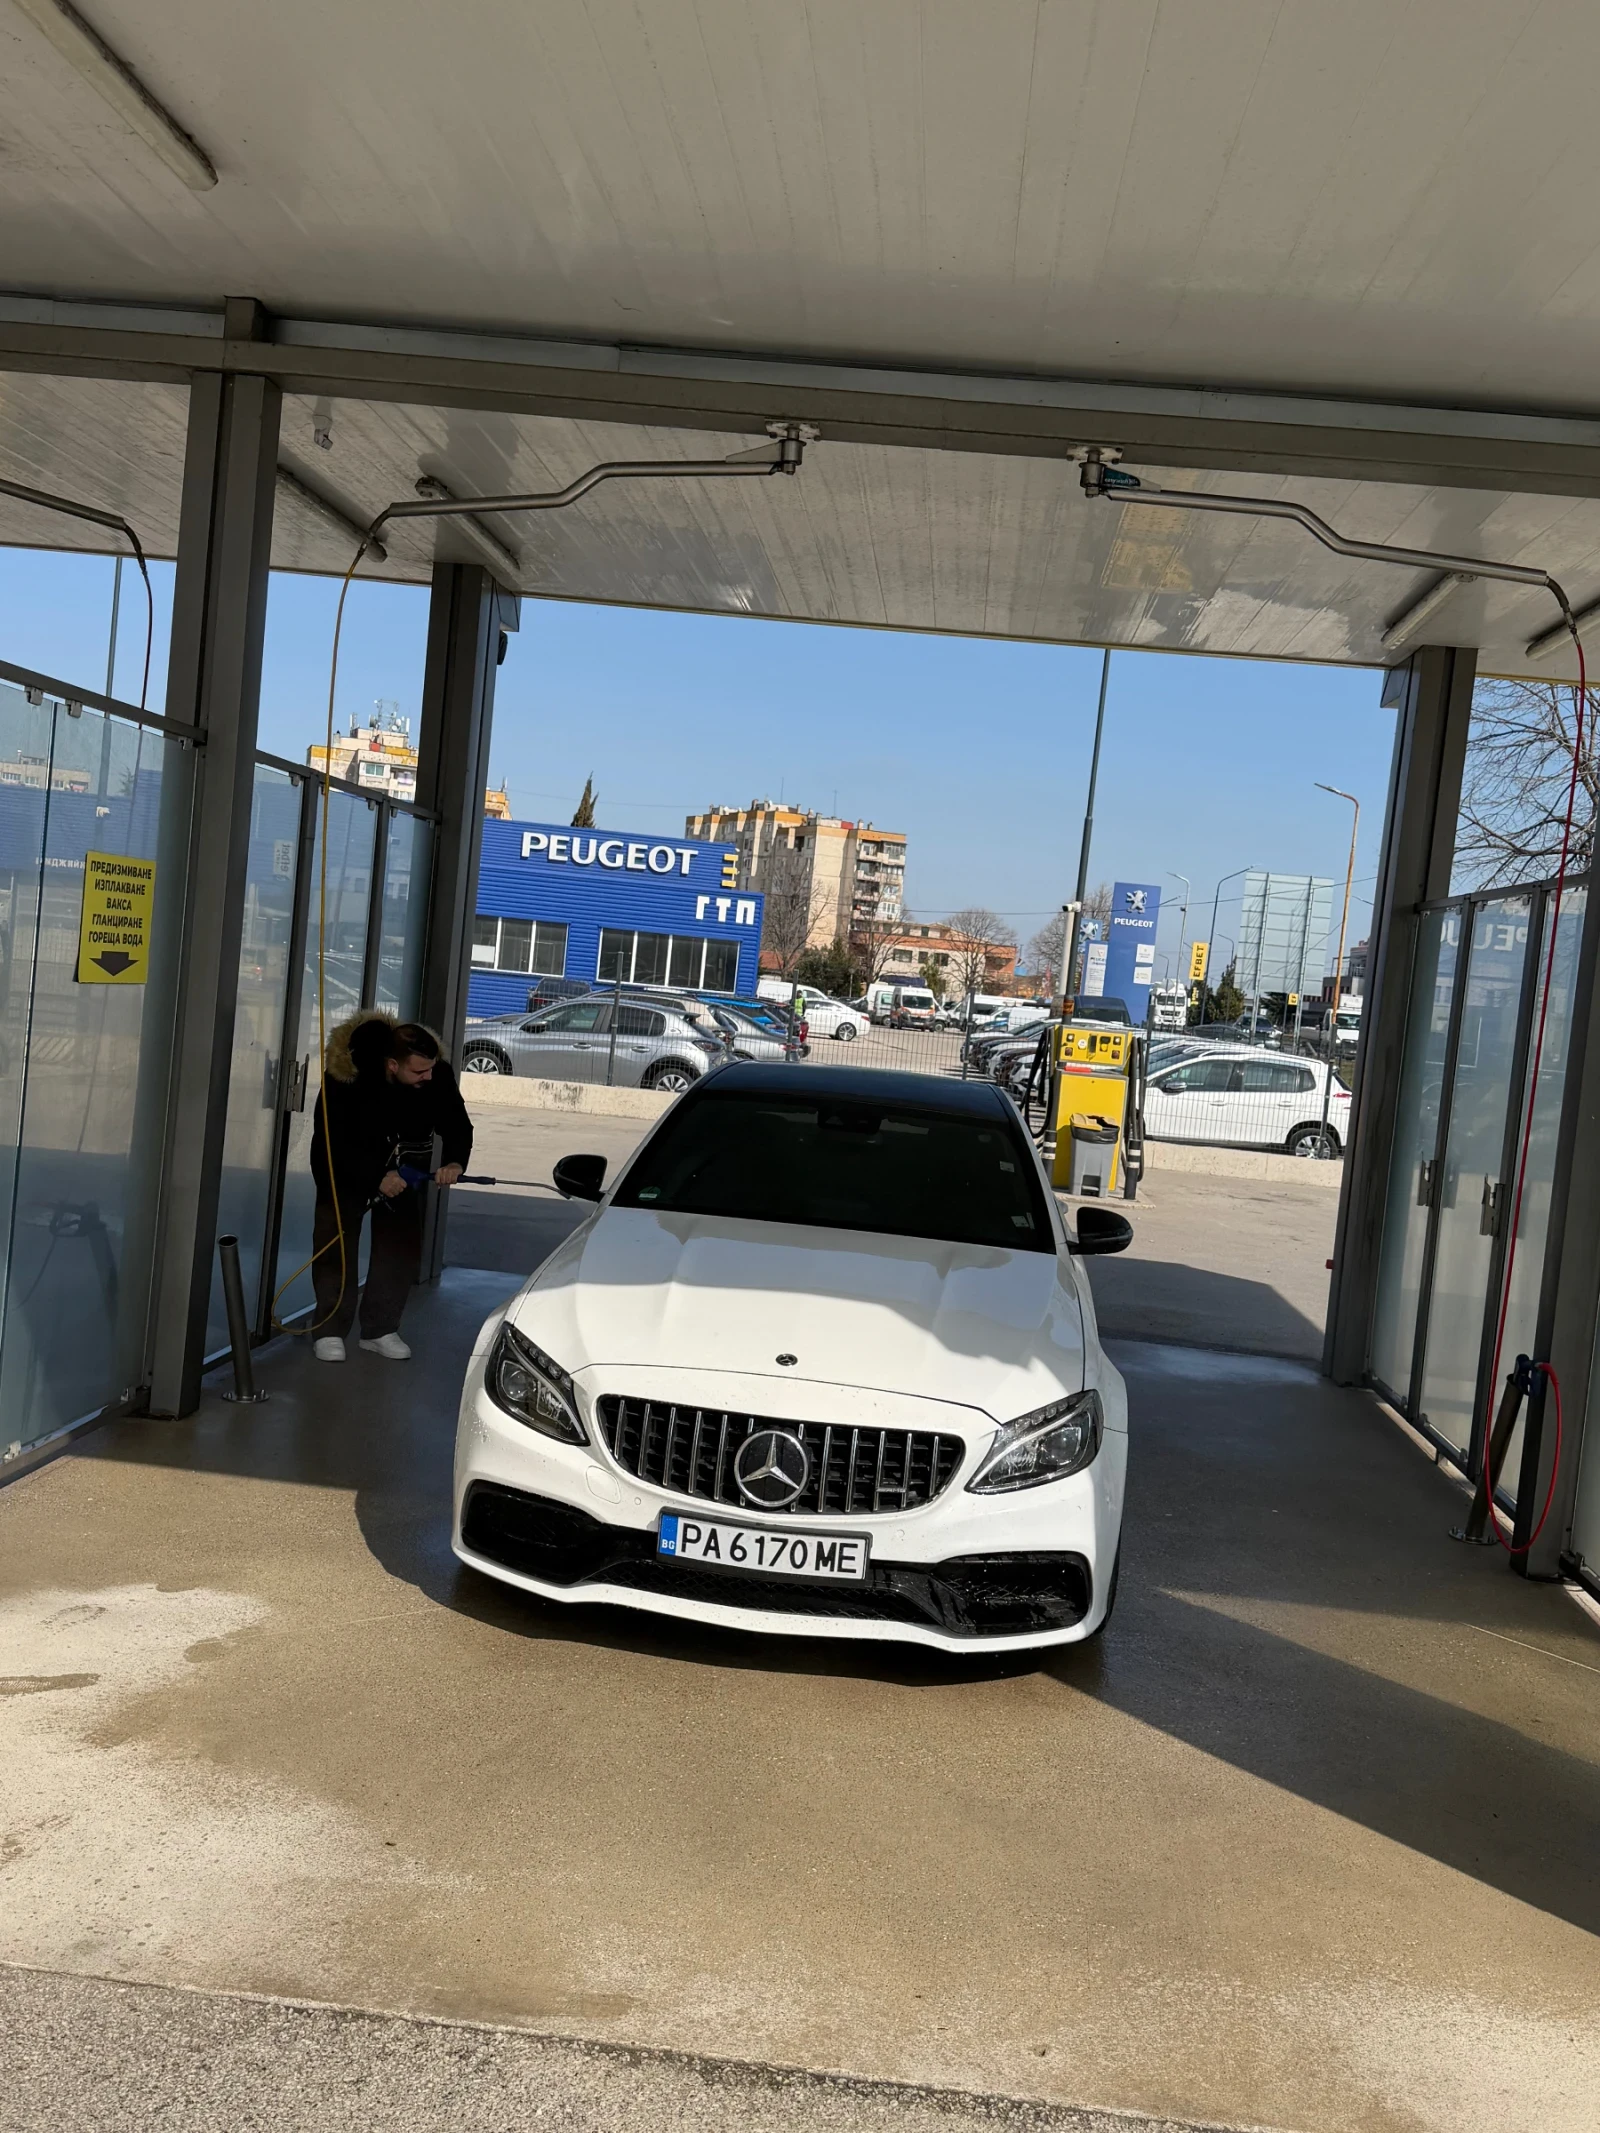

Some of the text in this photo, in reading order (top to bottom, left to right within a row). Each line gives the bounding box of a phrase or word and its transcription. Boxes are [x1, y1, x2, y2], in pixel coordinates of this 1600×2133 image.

[521, 831, 698, 875] PEUGEOT
[90, 860, 152, 880] ПРЕДИЗМИВАНЕ
[94, 878, 146, 895] ИЗПЛАКВАНЕ
[106, 897, 132, 911] ВАКСА
[695, 895, 756, 925] ГТП
[92, 913, 143, 929] ГЛАНЦИРАНЕ
[1114, 917, 1154, 928] PEUGEOT
[88, 931, 143, 948] ГОРЕЩА ВОДА
[1193, 945, 1204, 977] EFBET
[661, 1539, 675, 1550] BG
[729, 1532, 808, 1570] 6170
